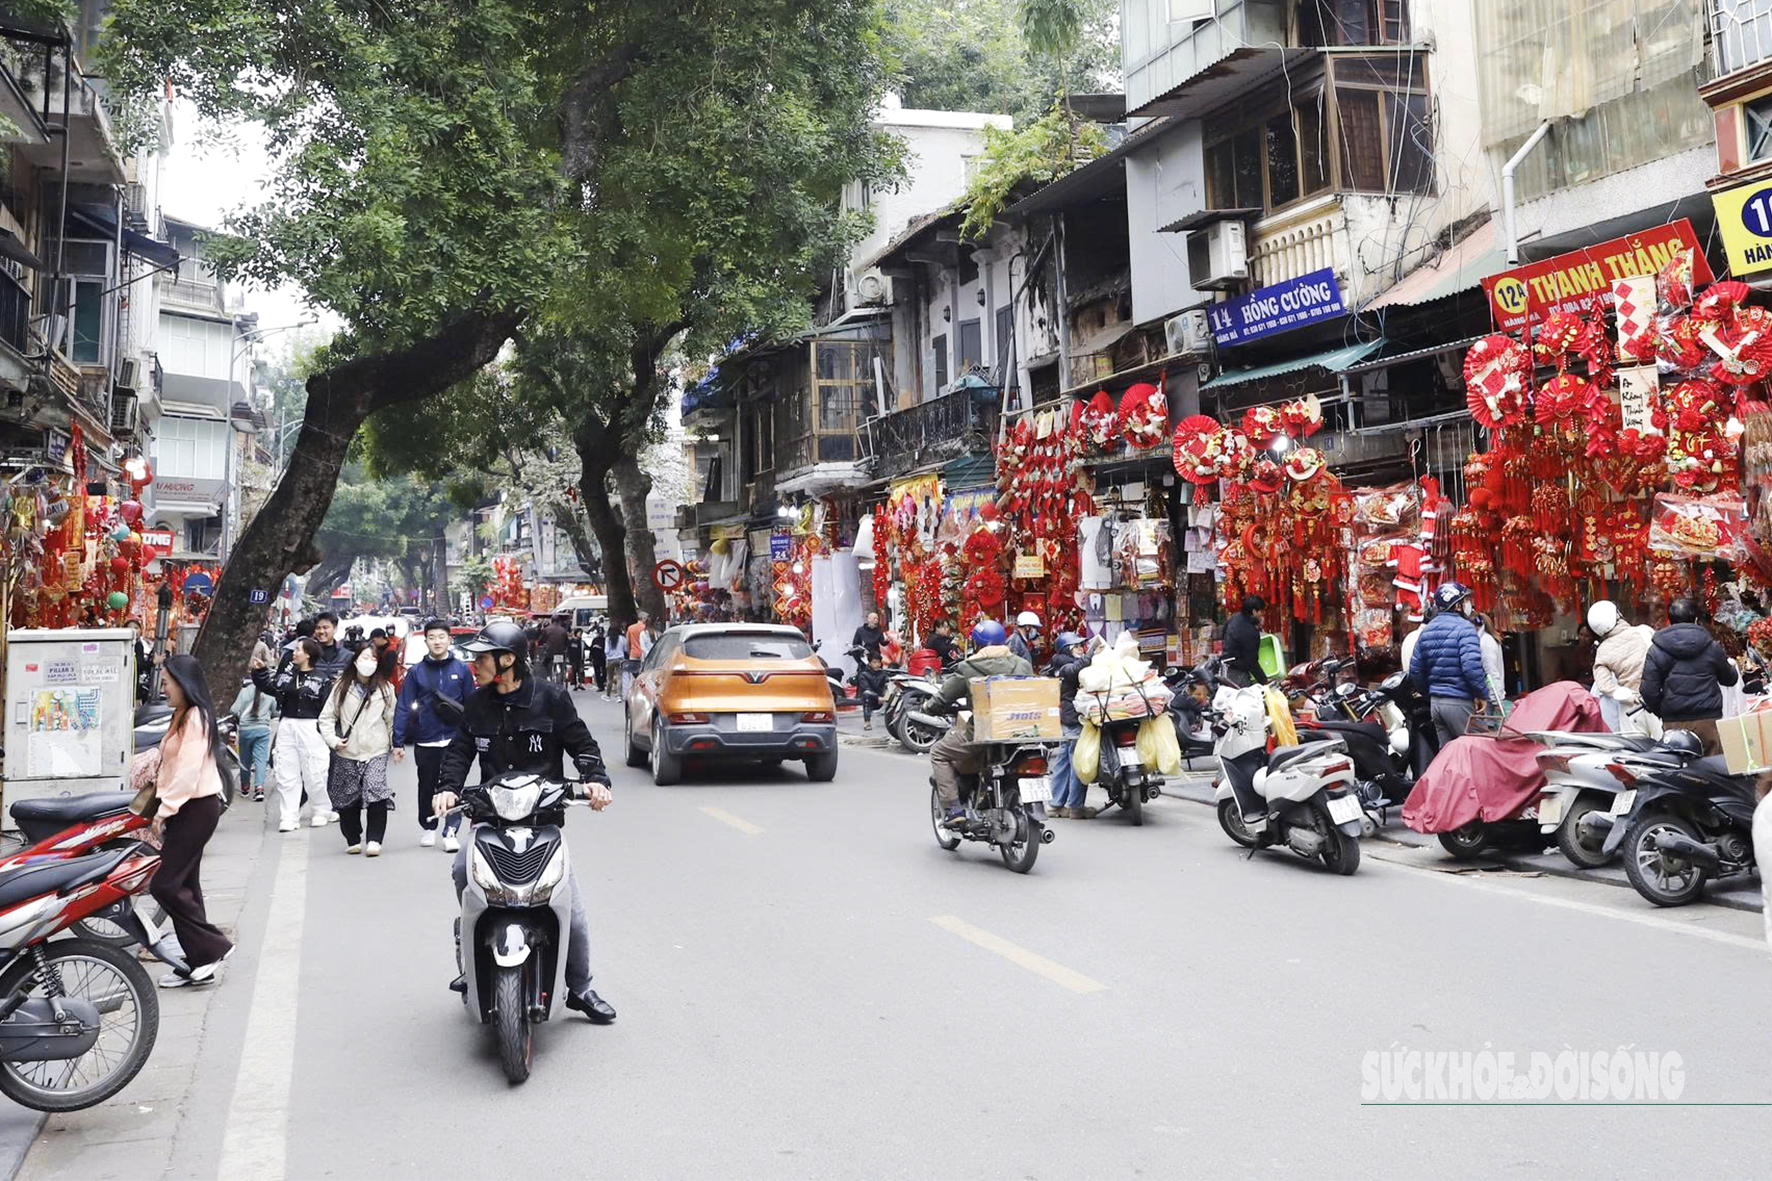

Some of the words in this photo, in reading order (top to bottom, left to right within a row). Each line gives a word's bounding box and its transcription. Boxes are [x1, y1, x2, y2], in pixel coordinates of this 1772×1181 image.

[1530, 260, 1607, 304] THANH
[1241, 293, 1279, 324] HỒNG
[1280, 281, 1331, 312] CƯỜNG
[1498, 283, 1526, 309] 12A
[1211, 307, 1232, 331] 14
[254, 591, 265, 601] 19
